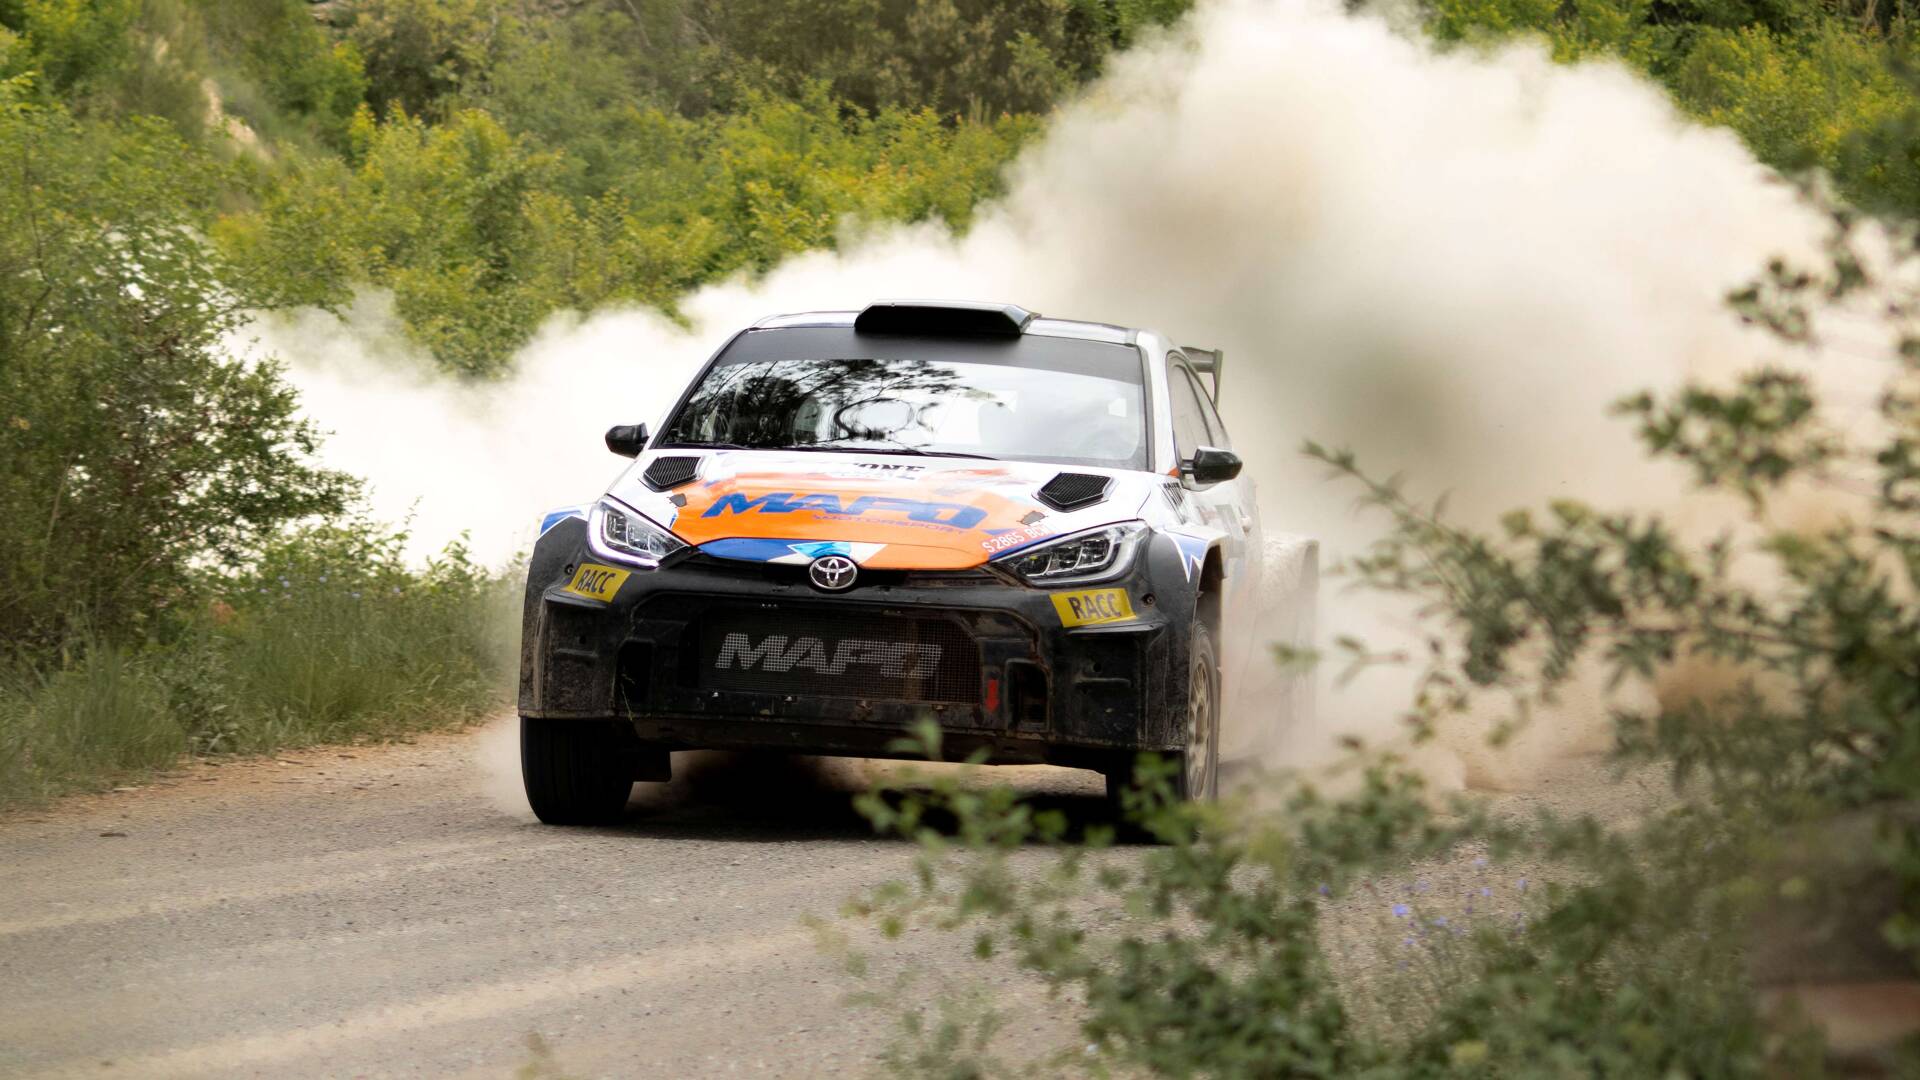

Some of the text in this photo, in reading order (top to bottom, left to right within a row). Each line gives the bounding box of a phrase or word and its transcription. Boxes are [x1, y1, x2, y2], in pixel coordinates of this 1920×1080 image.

[701, 492, 988, 529] MAPO
[575, 569, 616, 594] RACC
[1067, 592, 1121, 619] RACC
[715, 632, 943, 680] MAPO
